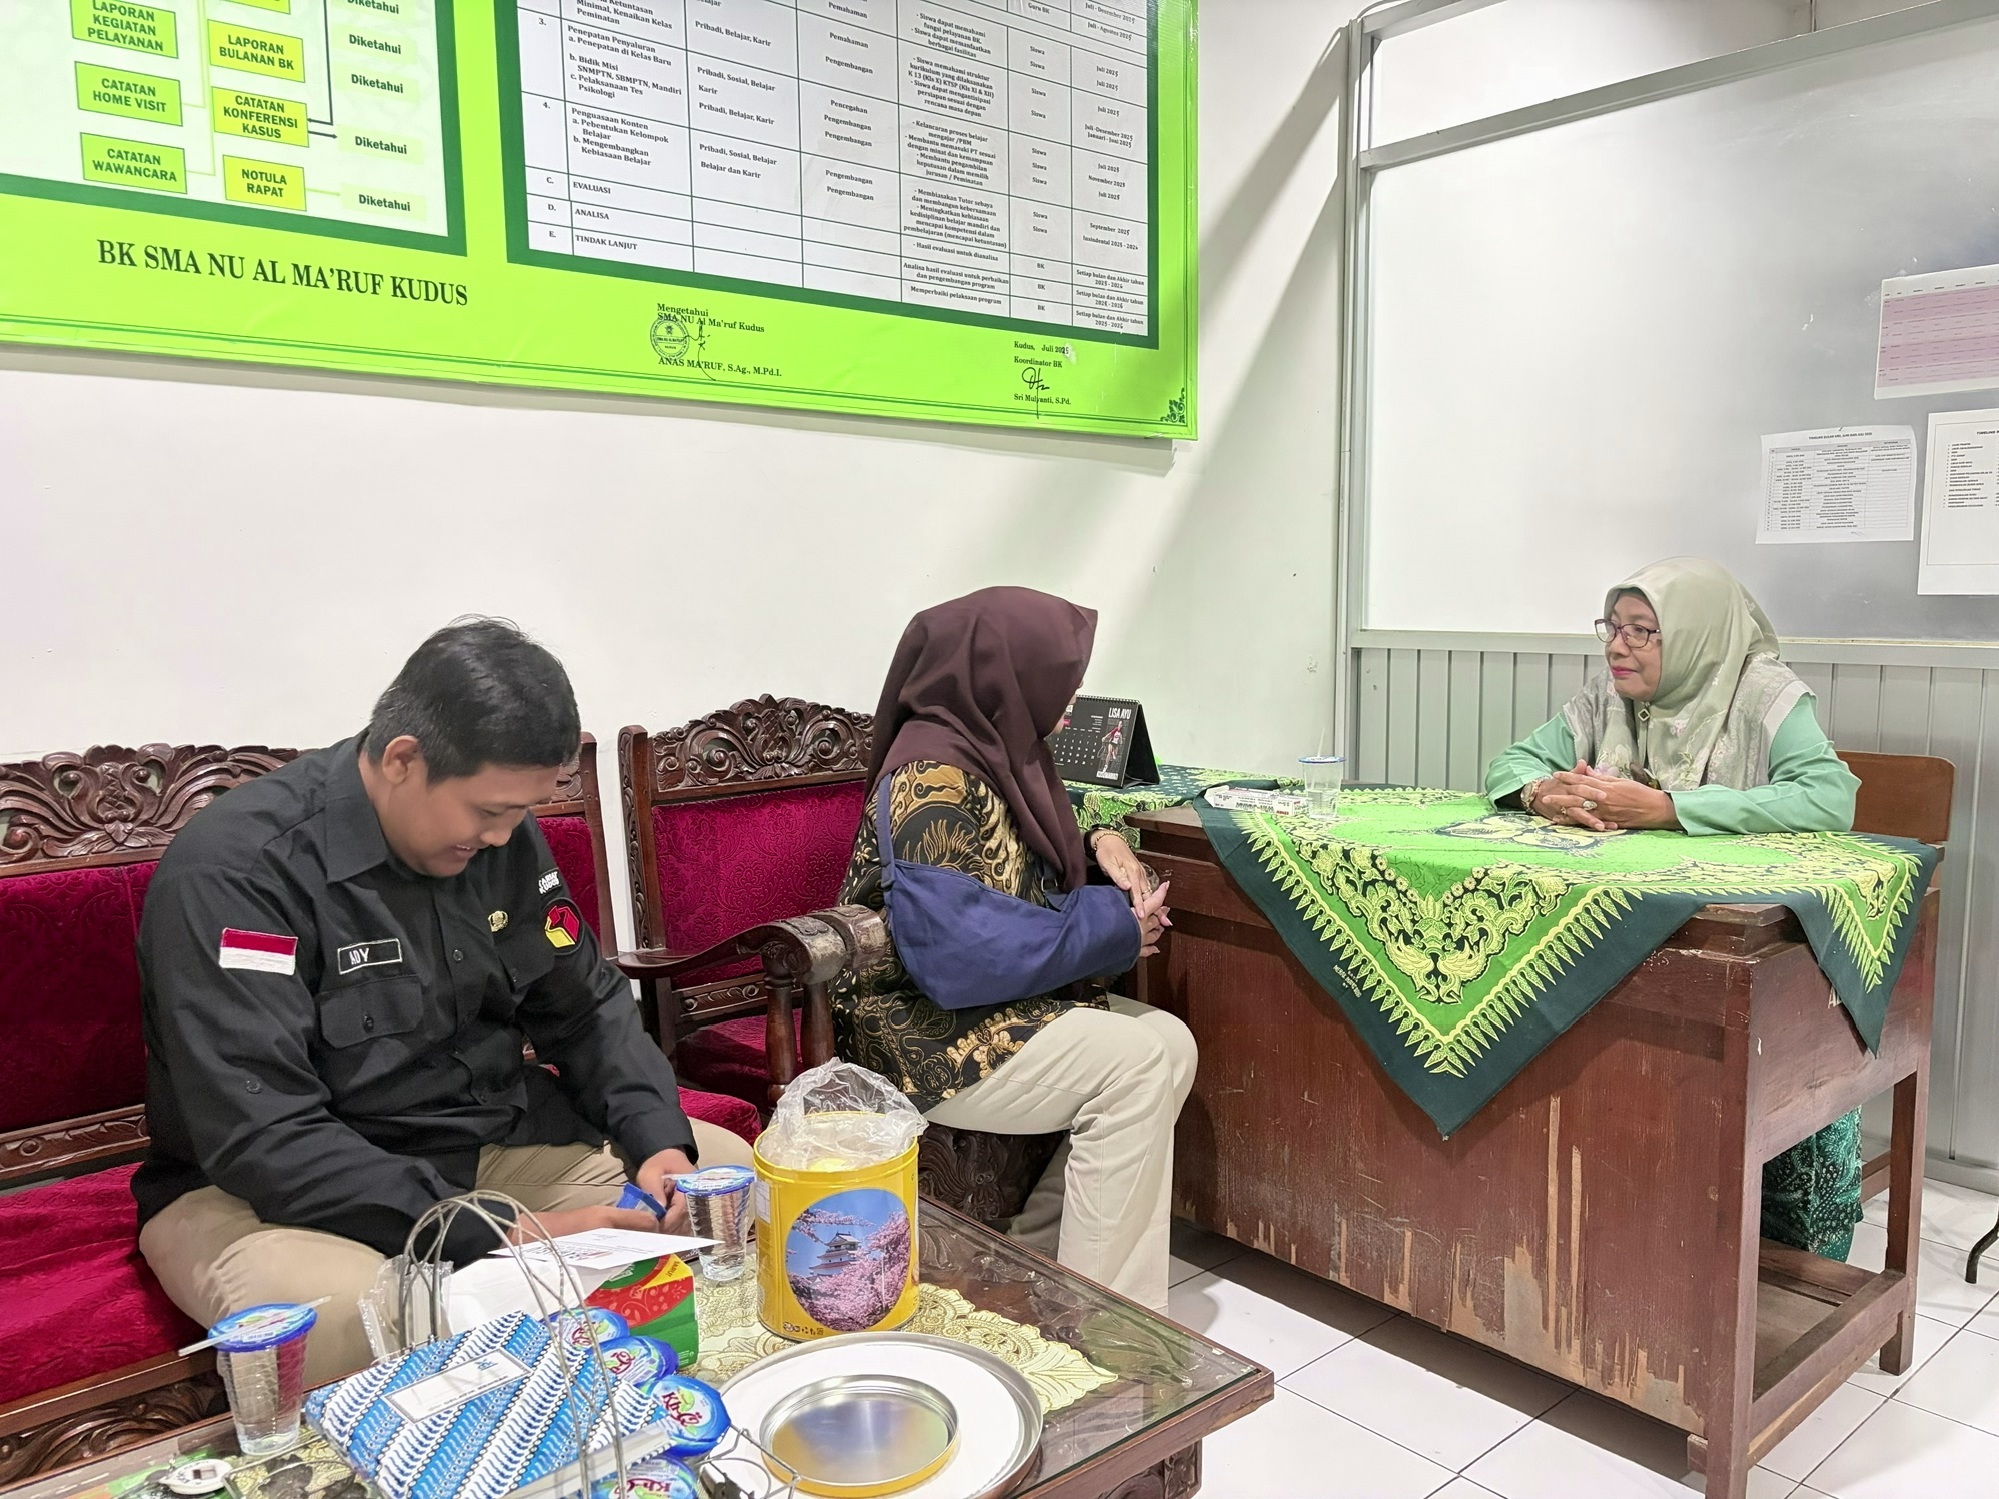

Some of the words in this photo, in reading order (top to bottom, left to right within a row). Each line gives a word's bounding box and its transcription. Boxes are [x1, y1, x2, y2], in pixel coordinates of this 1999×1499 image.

[93, 0, 154, 22] LAPORAN
[577, 0, 611, 14] Minimal,
[614, 8, 650, 23] Kenaikan
[652, 18, 672, 29] Kelas
[577, 8, 620, 24] Peminatan
[609, 0, 653, 15] Ketuntasan
[829, 2, 867, 18] Pemahaman
[93, 14, 156, 36] KEGIATAN
[695, 21, 724, 34] Pribadi,
[725, 29, 752, 42] Belajar,
[753, 36, 771, 46] Karir
[88, 27, 163, 51] PELAYANAN
[228, 35, 284, 55] LAPORAN
[349, 34, 401, 54] Diketahui
[568, 25, 610, 41] Penepatan
[612, 36, 655, 53] Penyaluran
[830, 32, 868, 48] Pemahaman
[219, 46, 275, 66] BULANAN
[278, 58, 294, 70] BK
[578, 37, 619, 53] Penepatan
[631, 50, 651, 61] Kelas
[653, 56, 671, 66] Baru
[1030, 46, 1045, 55] Siswa
[569, 53, 577, 61] b.
[579, 56, 600, 66] Bidik
[602, 61, 618, 71] Misi
[826, 56, 873, 74] Pengembangan
[1030, 61, 1045, 70] Siswa
[101, 78, 156, 97] CATATAN
[351, 74, 403, 93] Diketahui
[578, 65, 614, 80] SNMPTN,
[616, 74, 650, 88] SBMPTN,
[652, 82, 681, 95] Mandiri
[579, 74, 628, 92] Pelaksanaan
[630, 86, 643, 95] Tes
[698, 67, 726, 80] Pribadi,
[727, 74, 749, 86] Sosial,
[751, 80, 775, 91] Belajar
[579, 84, 615, 99] Psikologi
[699, 85, 718, 94] Karir
[1031, 88, 1046, 96] Siswa
[93, 90, 131, 106] HOME
[135, 98, 166, 112] VISIT
[235, 95, 284, 113] CATATAN
[831, 100, 868, 114] Pencegahan
[224, 106, 297, 128] KONFERENSI
[572, 107, 619, 123] Penguasaan
[621, 118, 648, 130] Konten
[699, 102, 727, 115] Pribadi,
[729, 109, 755, 121] Belajar,
[756, 115, 774, 124] Karir
[1031, 110, 1046, 119] Siswa
[242, 123, 281, 138] KASUS
[581, 119, 628, 134] Pebentukan
[630, 129, 668, 143] Kelompok
[824, 114, 871, 131] Pengembangan
[583, 128, 611, 140] Belajar
[825, 131, 872, 147] Pengembangan
[355, 136, 407, 154] Diketahui
[573, 135, 581, 143] b.
[583, 137, 649, 156] Mengembangkan
[1032, 148, 1046, 156] Siswa
[107, 148, 161, 165] CATATAN
[582, 146, 622, 160] Kebiasaan
[624, 155, 651, 165] Belajar
[700, 144, 728, 156] Pribadi,
[729, 150, 751, 160] Sosial,
[753, 155, 777, 165] Belajar
[92, 160, 177, 182] WAWANCARA
[701, 161, 726, 171] Belajar
[742, 169, 761, 178] Karir
[1032, 162, 1047, 170] Siswa
[242, 169, 287, 185] NOTULA
[826, 170, 873, 184] Pengembangan
[1032, 177, 1047, 185] Siswa
[247, 183, 283, 197] RAPAT
[573, 182, 610, 194] EVALUASI
[827, 186, 874, 201] Pengembangan
[359, 194, 410, 211] Diketahui
[575, 209, 609, 220] ANALISA
[575, 235, 606, 245] TINDAK
[608, 240, 637, 249] LANJUT
[97, 240, 137, 266] BK
[144, 245, 201, 274] SMA
[207, 253, 245, 279] NU
[253, 259, 285, 284] AL
[291, 263, 384, 295] MA'RUF
[390, 276, 467, 306] KUDUS
[929, 275, 971, 286] pengembangan
[911, 286, 948, 296] Memperbaiki
[950, 293, 977, 301] pelaksaan
[657, 303, 708, 317] Mengetahui
[657, 313, 679, 323] SMA
[680, 315, 694, 325] NU
[697, 317, 705, 327] Al
[709, 318, 737, 329] Ma'ruf
[739, 322, 764, 332] Kudus
[1014, 341, 1035, 350] Kudus,
[1041, 344, 1054, 353] Juli
[1055, 346, 1069, 355] 2025
[659, 356, 684, 366] ANAS
[687, 360, 725, 372] MA'RUF,
[728, 364, 751, 374] S.Ag.,
[753, 366, 782, 376] M.Pd.I.
[1014, 356, 1052, 366] Koordinator
[1053, 360, 1062, 368] BK
[1025, 394, 1054, 404] Mulyanti,
[1108, 707, 1121, 718] LISA
[1120, 709, 1132, 719] AYU
[349, 947, 371, 965] ADY
